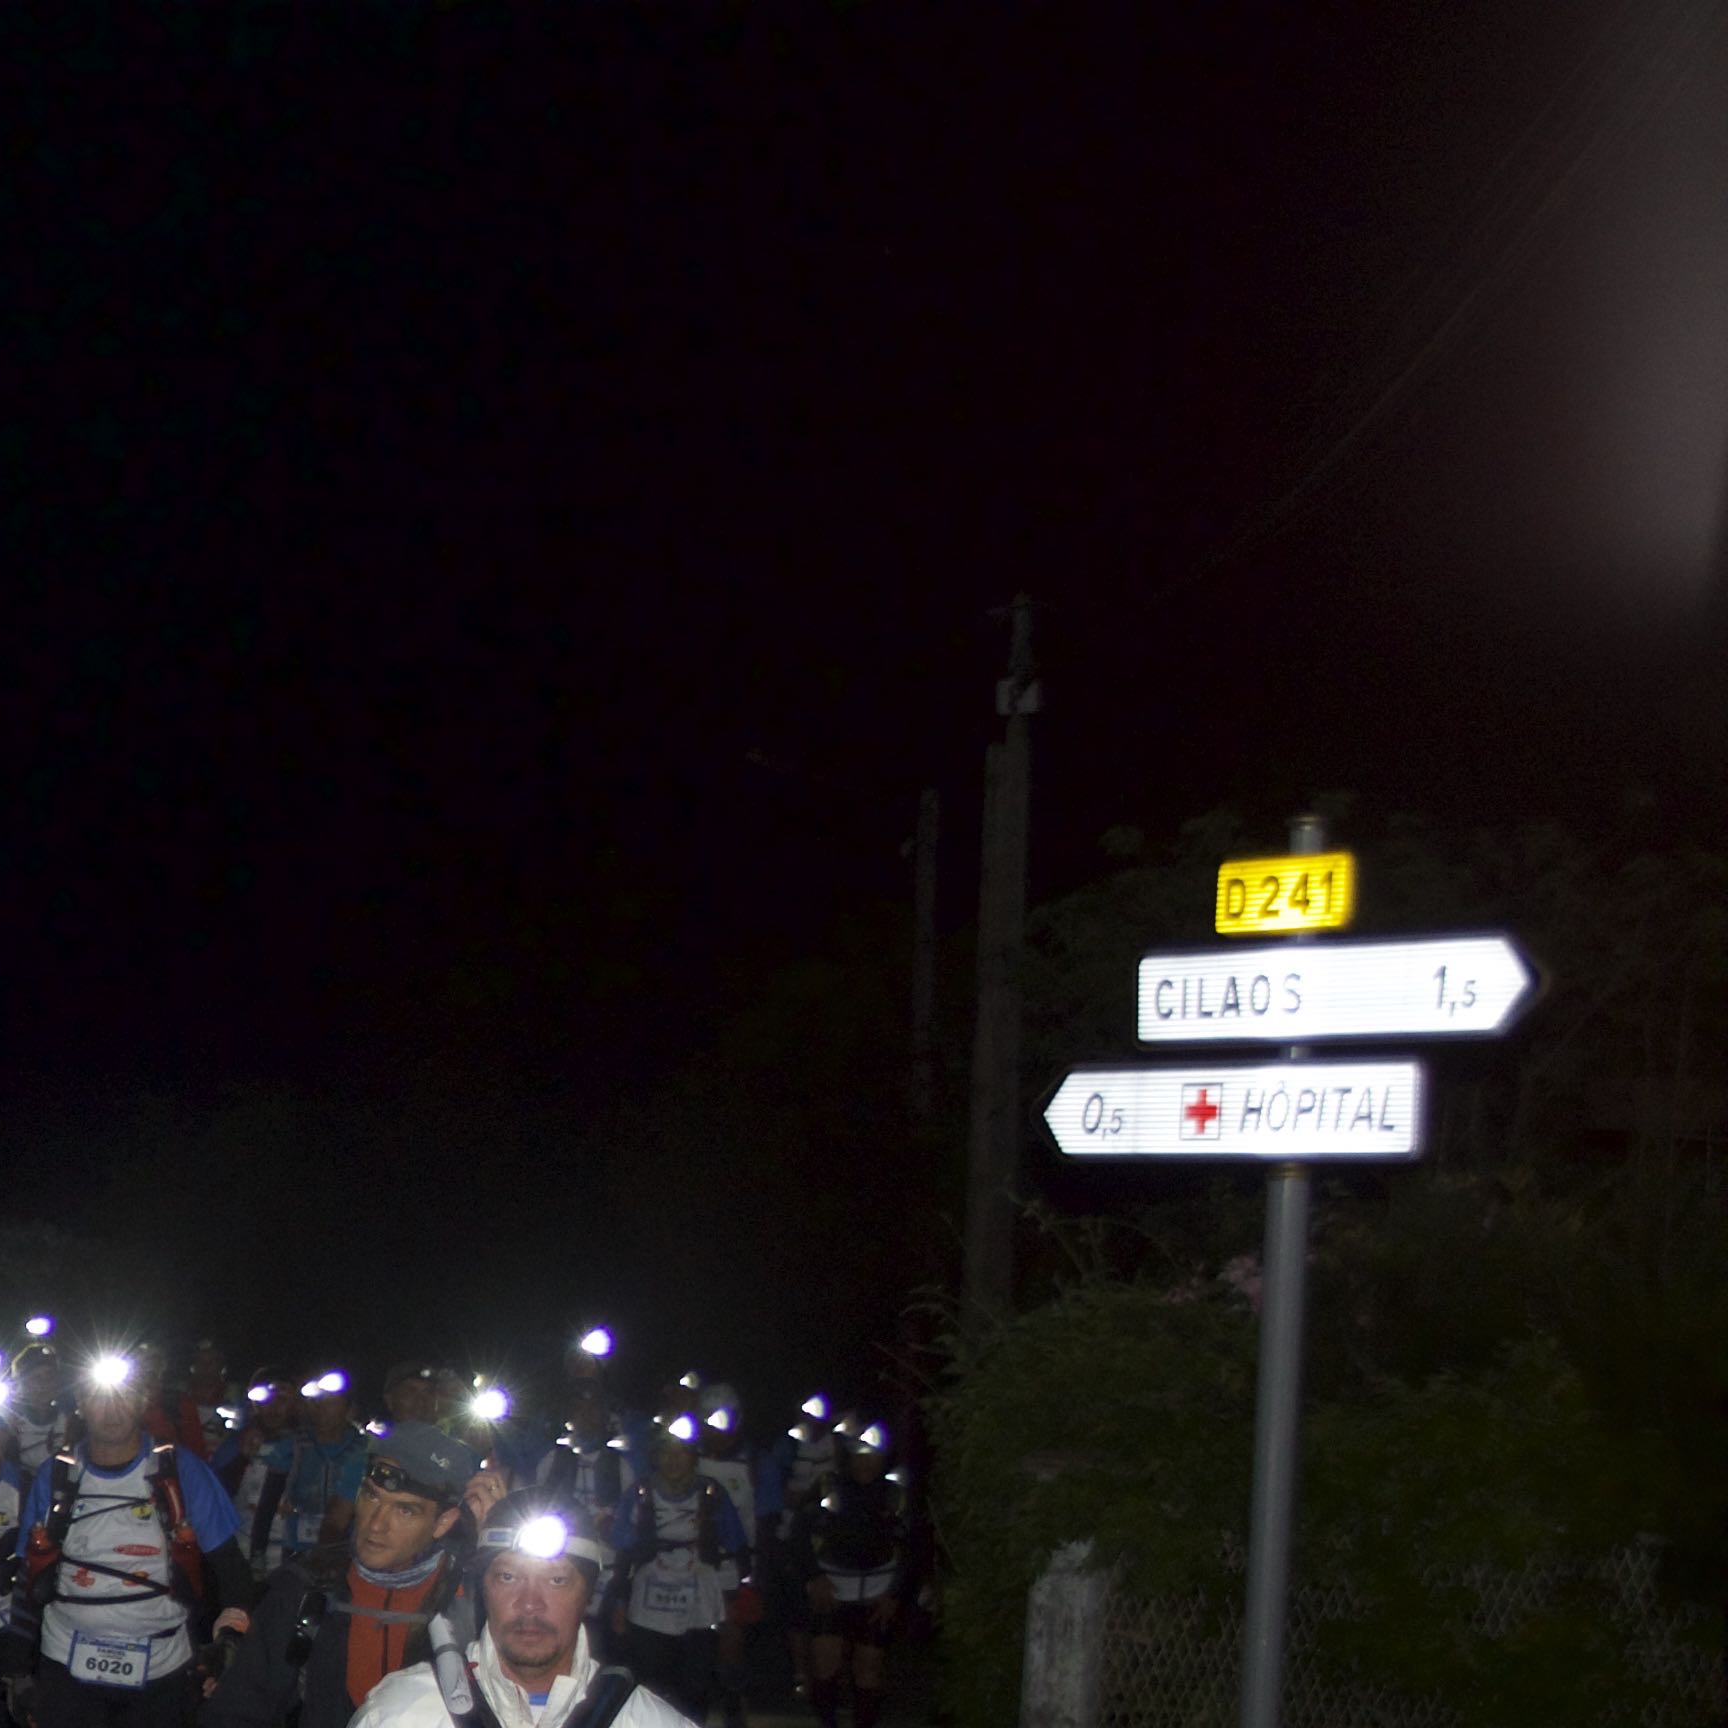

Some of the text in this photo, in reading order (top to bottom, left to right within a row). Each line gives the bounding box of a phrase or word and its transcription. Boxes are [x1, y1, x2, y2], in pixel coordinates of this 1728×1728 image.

[1224, 870, 1335, 919] D 241
[1154, 965, 1477, 1020] CILAOS 1,5
[1082, 1080, 1397, 1142] 0,5 HÔPITAL
[85, 1657, 134, 1676] 6020
